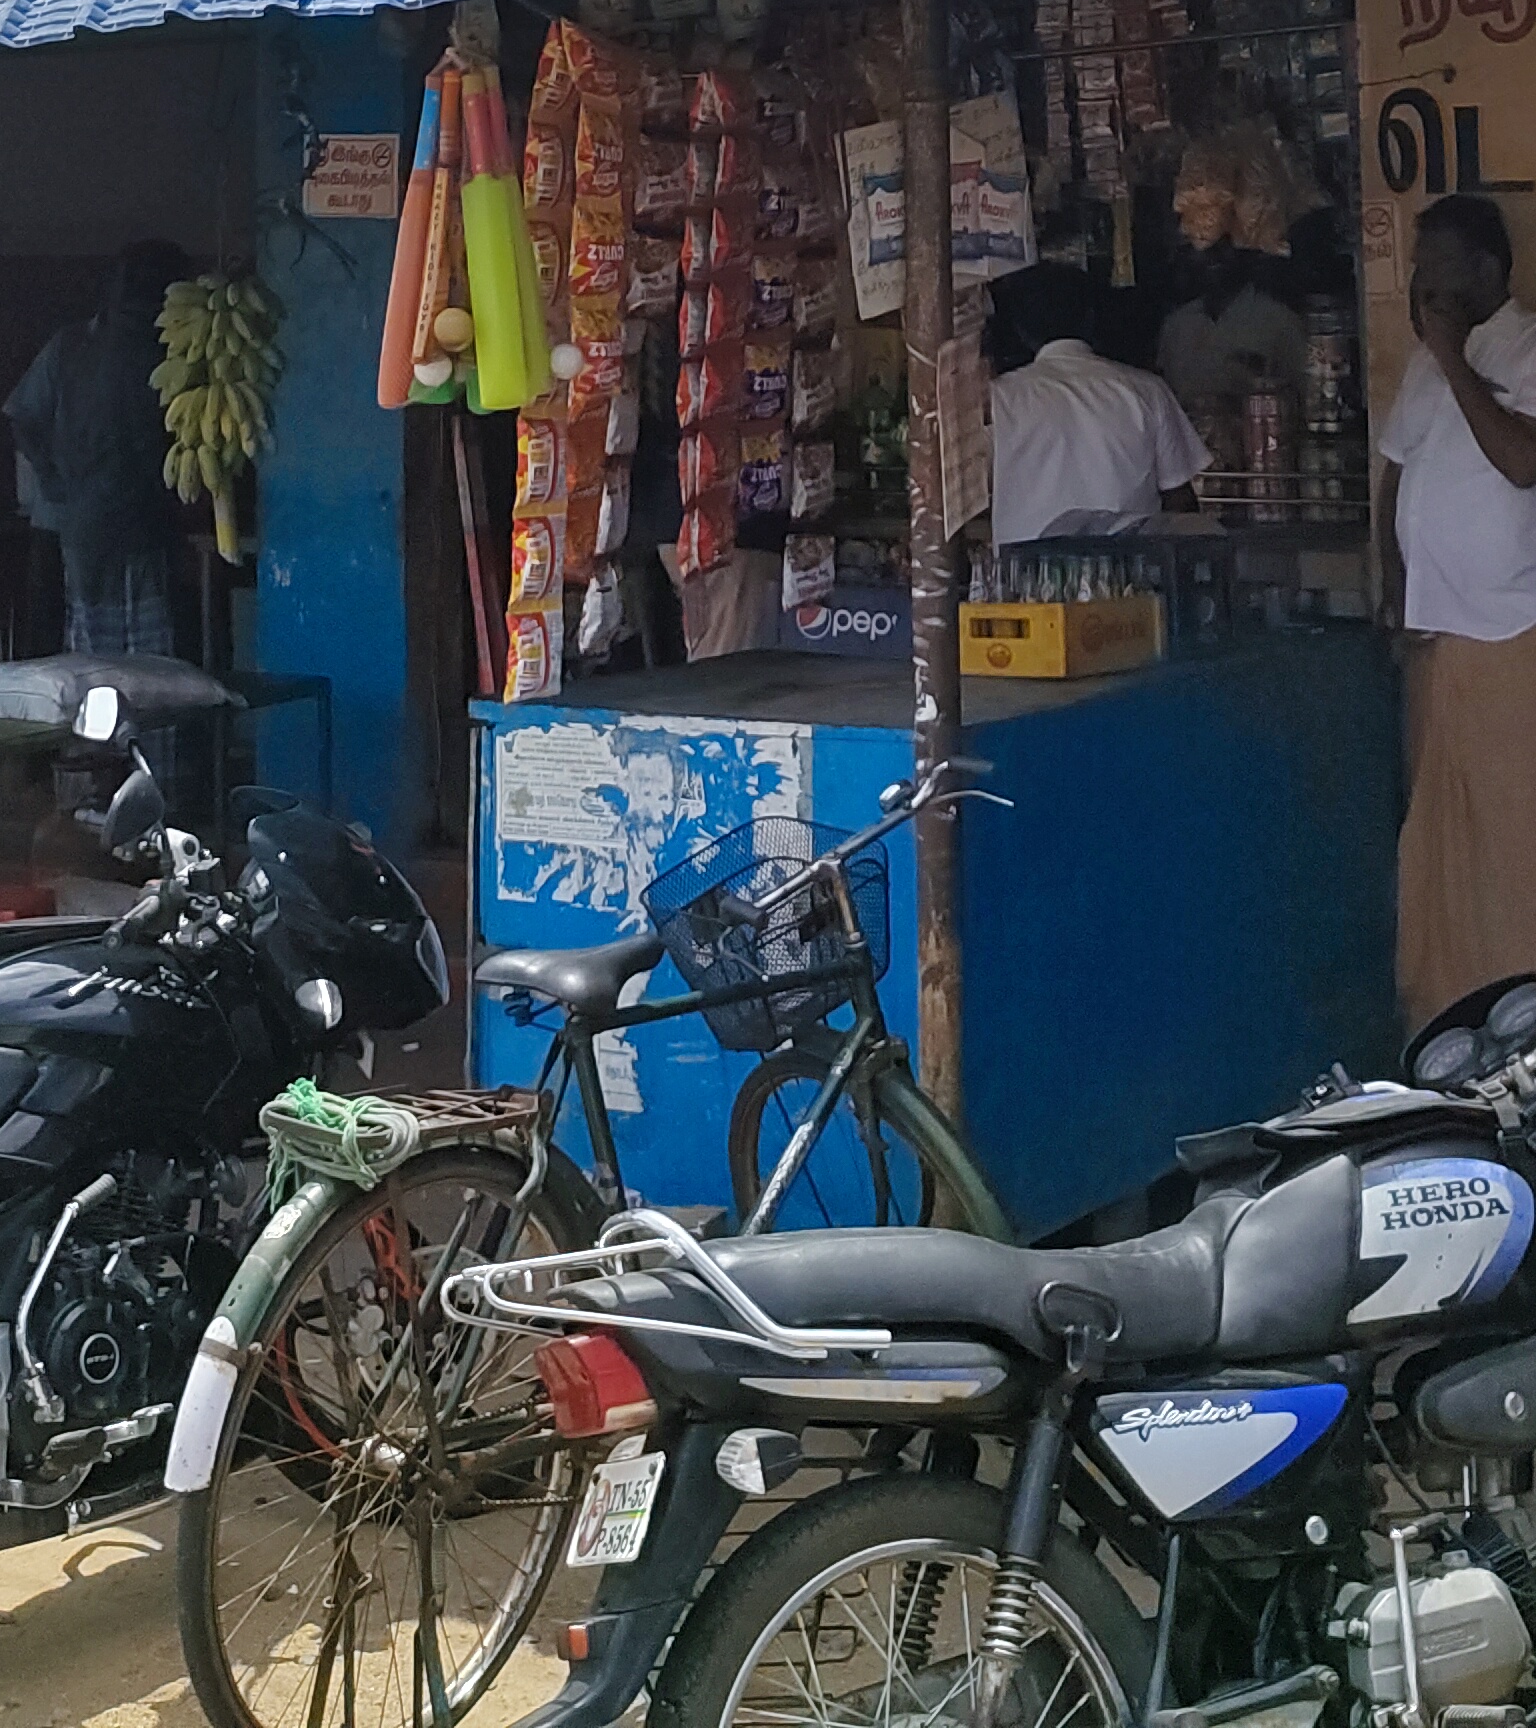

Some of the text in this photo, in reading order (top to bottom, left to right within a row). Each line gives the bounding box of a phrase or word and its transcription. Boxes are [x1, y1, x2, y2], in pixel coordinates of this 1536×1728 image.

[832, 609, 897, 641] pep
[1387, 1177, 1492, 1208] HERO
[1380, 1196, 1511, 1231] HONDA
